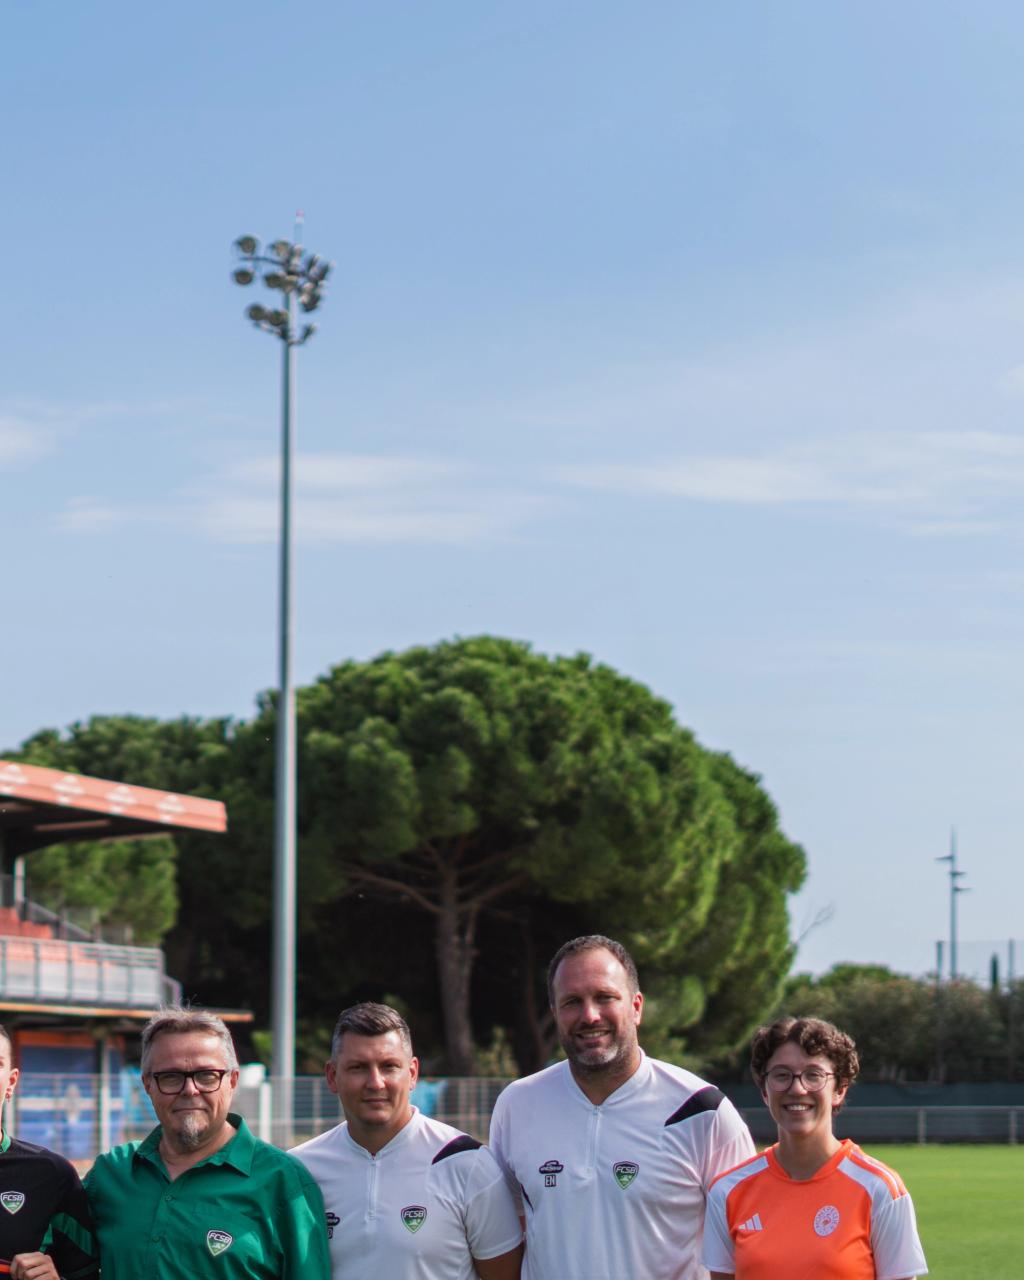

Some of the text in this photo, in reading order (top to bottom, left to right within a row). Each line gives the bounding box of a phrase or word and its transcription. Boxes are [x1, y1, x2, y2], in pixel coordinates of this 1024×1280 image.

[616, 1166, 637, 1174] FCSB
[403, 1210, 424, 1218] FCSB
[209, 1232, 232, 1244] FCSB
